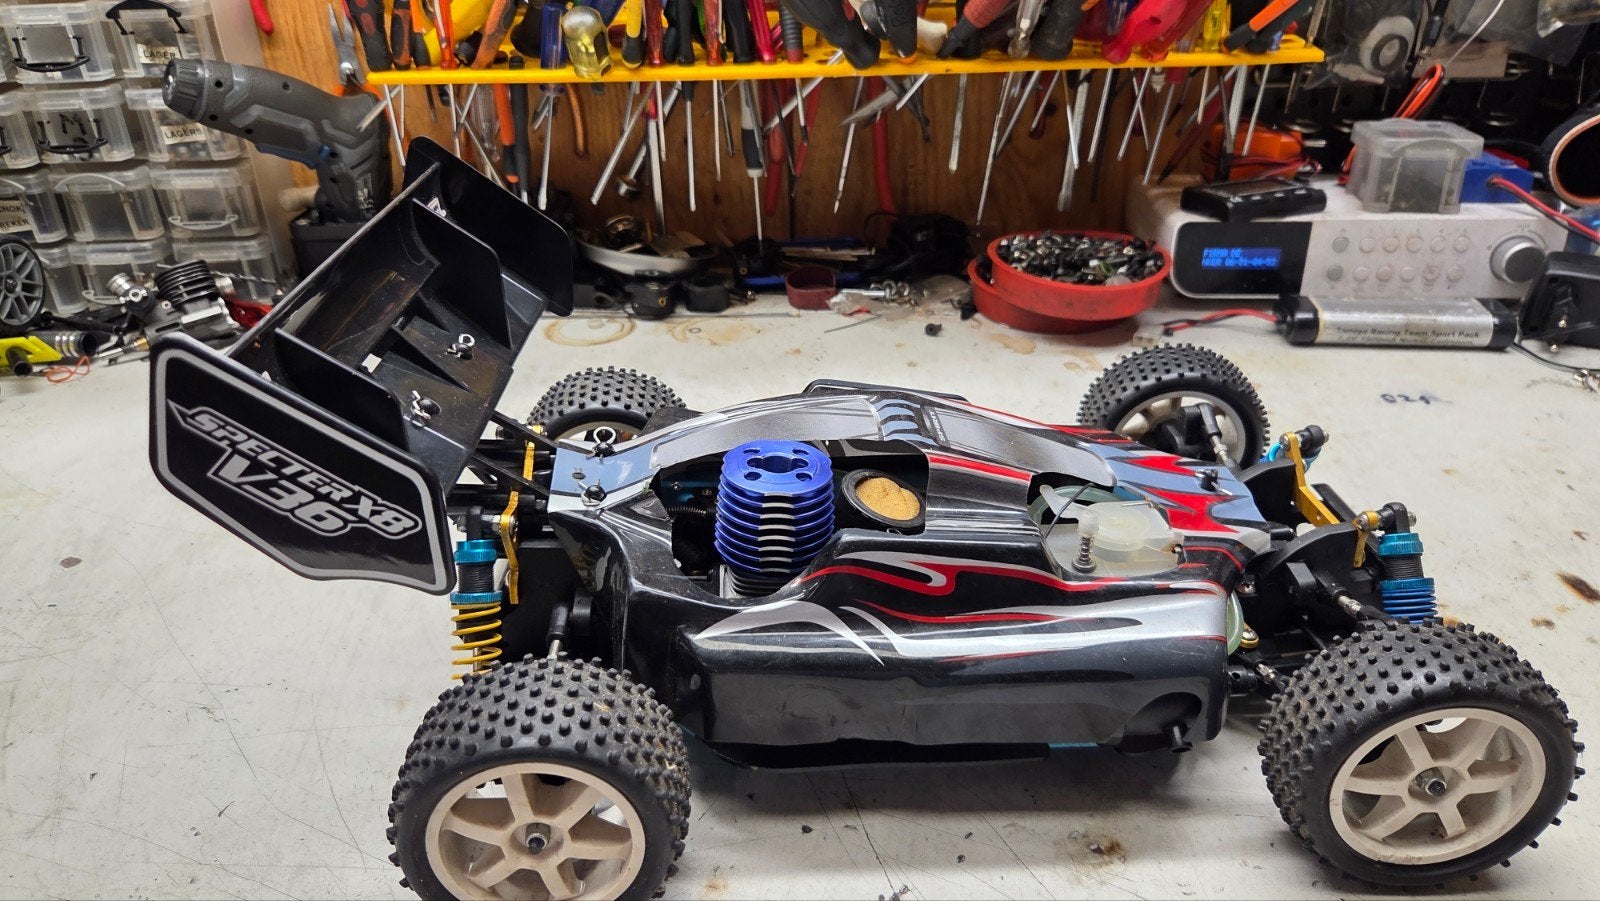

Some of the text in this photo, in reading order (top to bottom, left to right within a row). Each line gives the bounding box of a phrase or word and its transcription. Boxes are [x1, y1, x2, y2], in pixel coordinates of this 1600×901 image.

[143, 50, 176, 60] LAGER
[164, 128, 203, 139] LAGERS
[1371, 328, 1401, 336] Racing
[1431, 330, 1456, 338] Sport
[186, 412, 415, 534] SPECTER X8
[217, 453, 360, 531] V36
